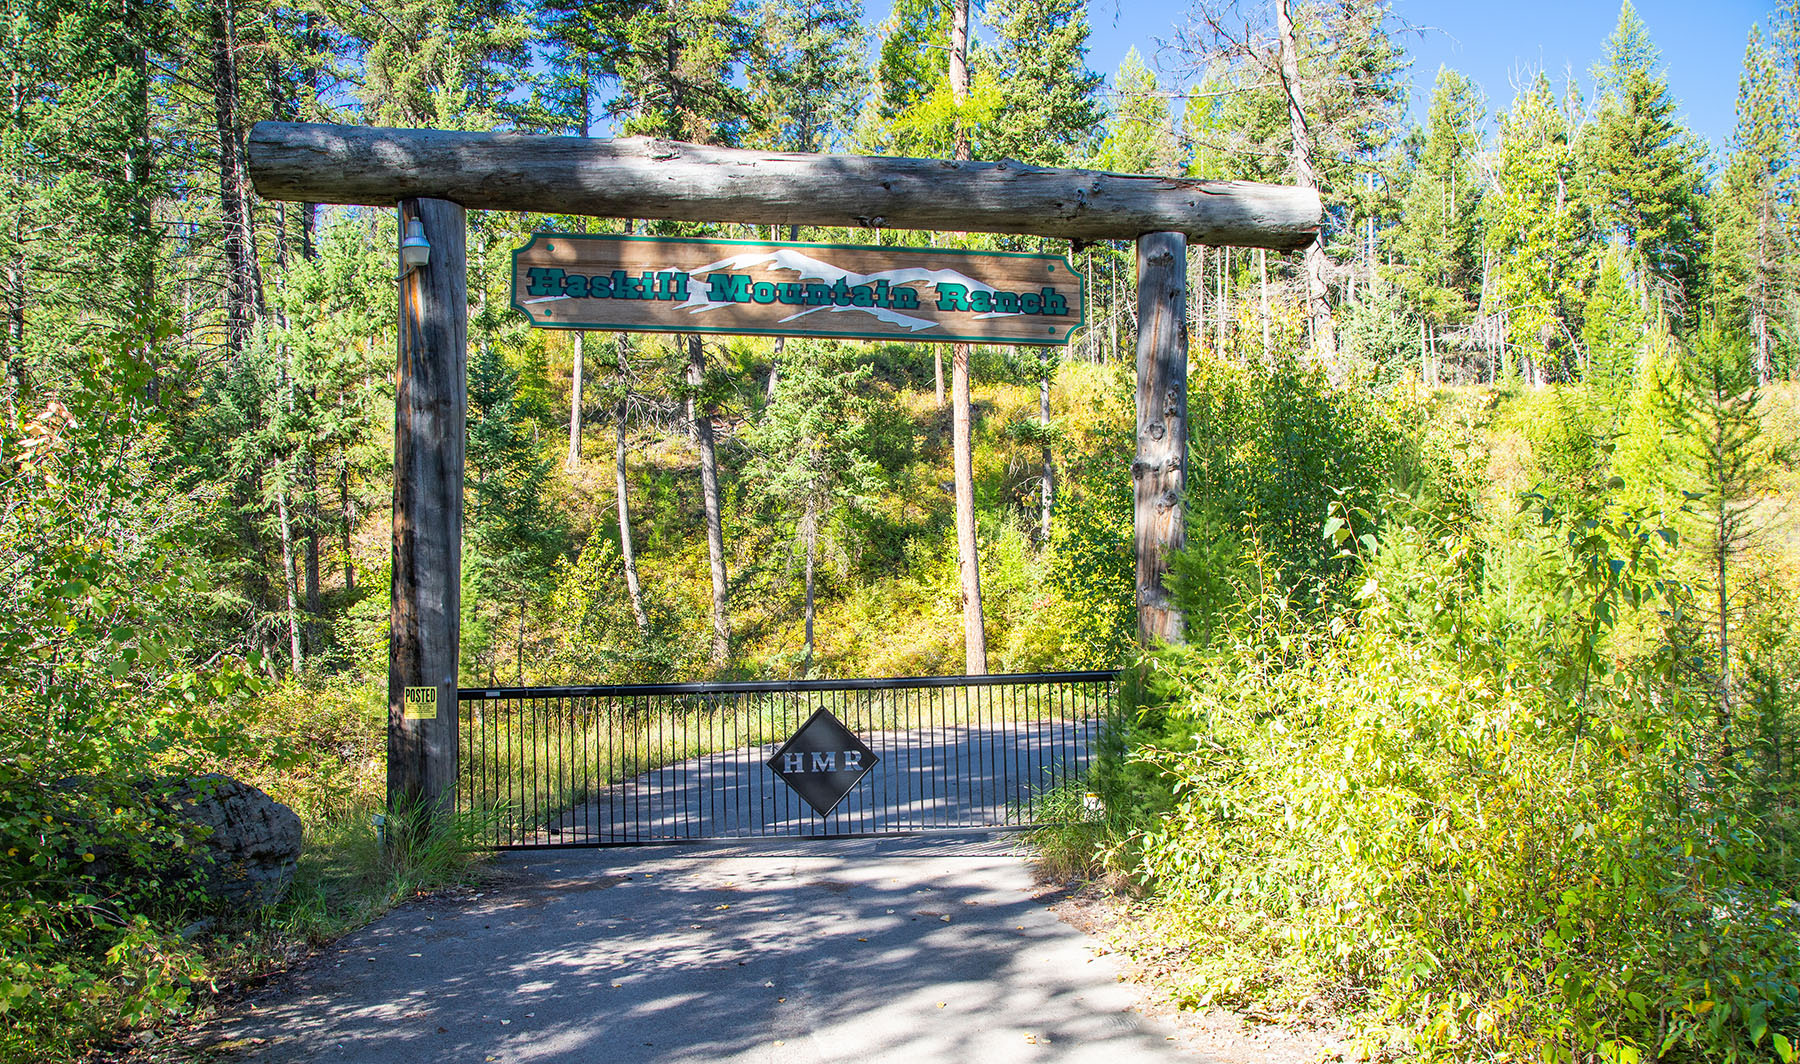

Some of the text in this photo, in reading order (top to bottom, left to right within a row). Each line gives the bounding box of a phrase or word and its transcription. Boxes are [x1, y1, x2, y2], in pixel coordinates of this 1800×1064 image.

[526, 267, 1069, 316] Haskill Mountain Ranch
[405, 688, 436, 702] POSTED
[783, 750, 863, 773] HMR
